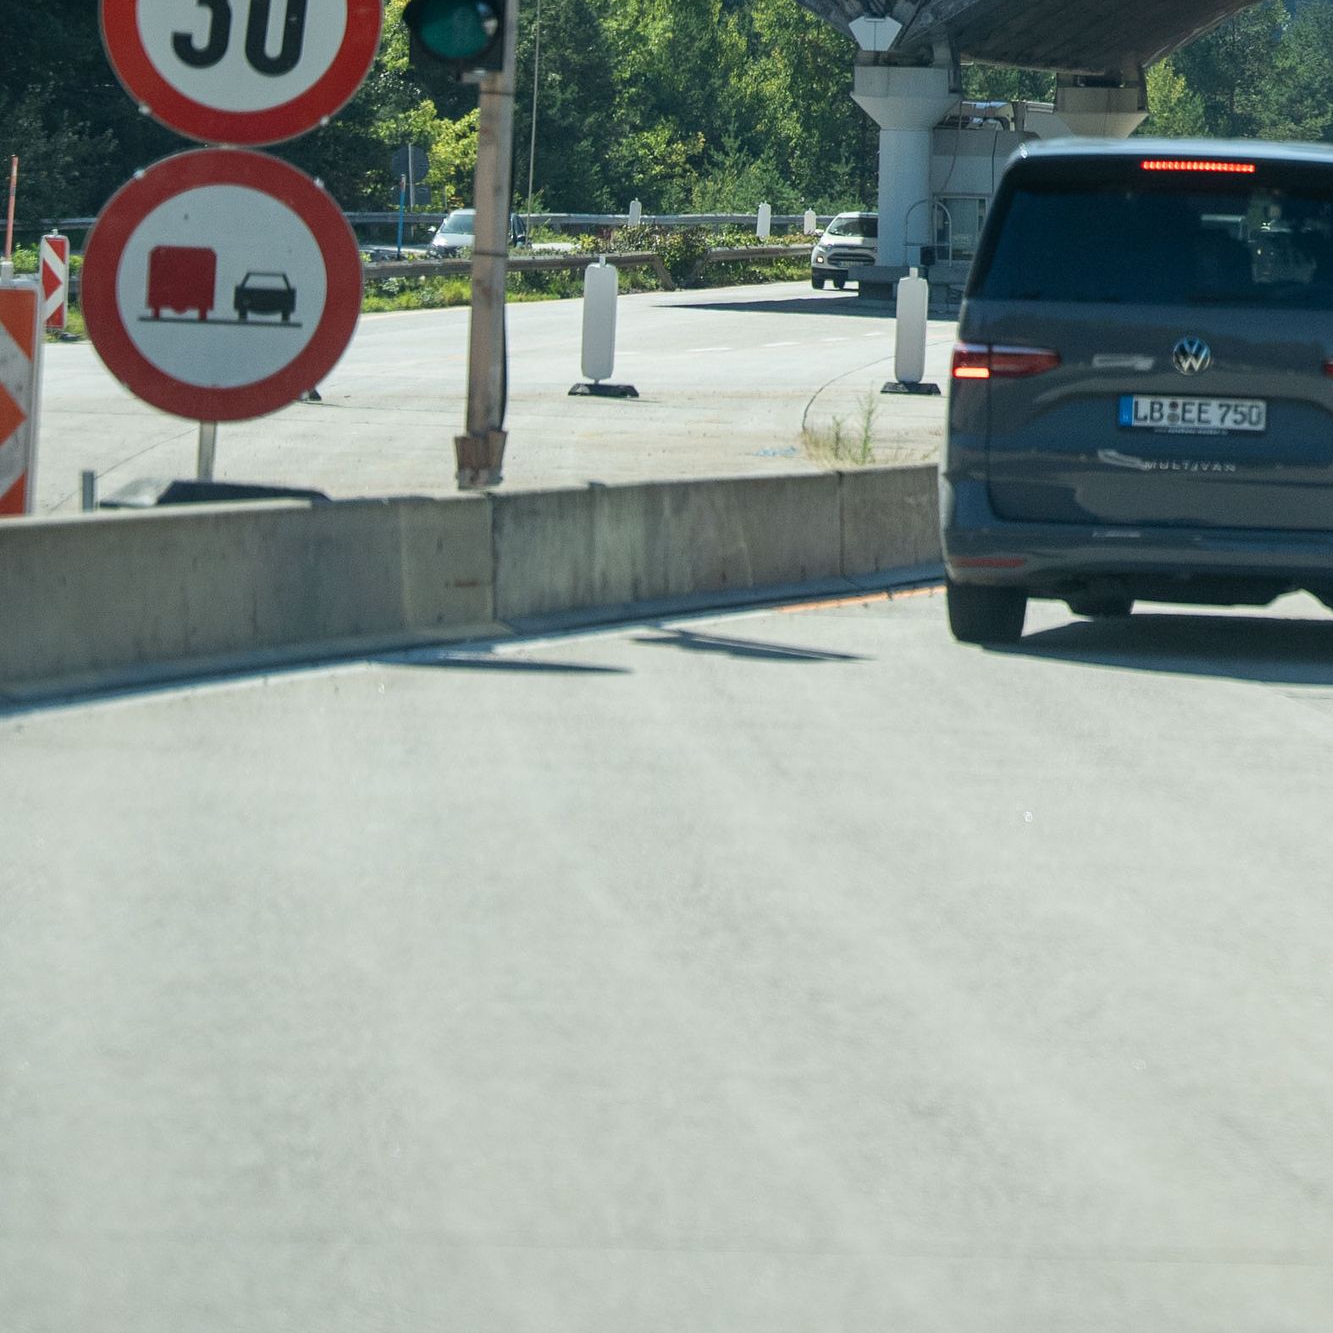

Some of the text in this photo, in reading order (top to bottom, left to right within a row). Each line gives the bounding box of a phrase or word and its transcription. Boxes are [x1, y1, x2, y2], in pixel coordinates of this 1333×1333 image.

[1133, 400, 1263, 427] LB EE 750
